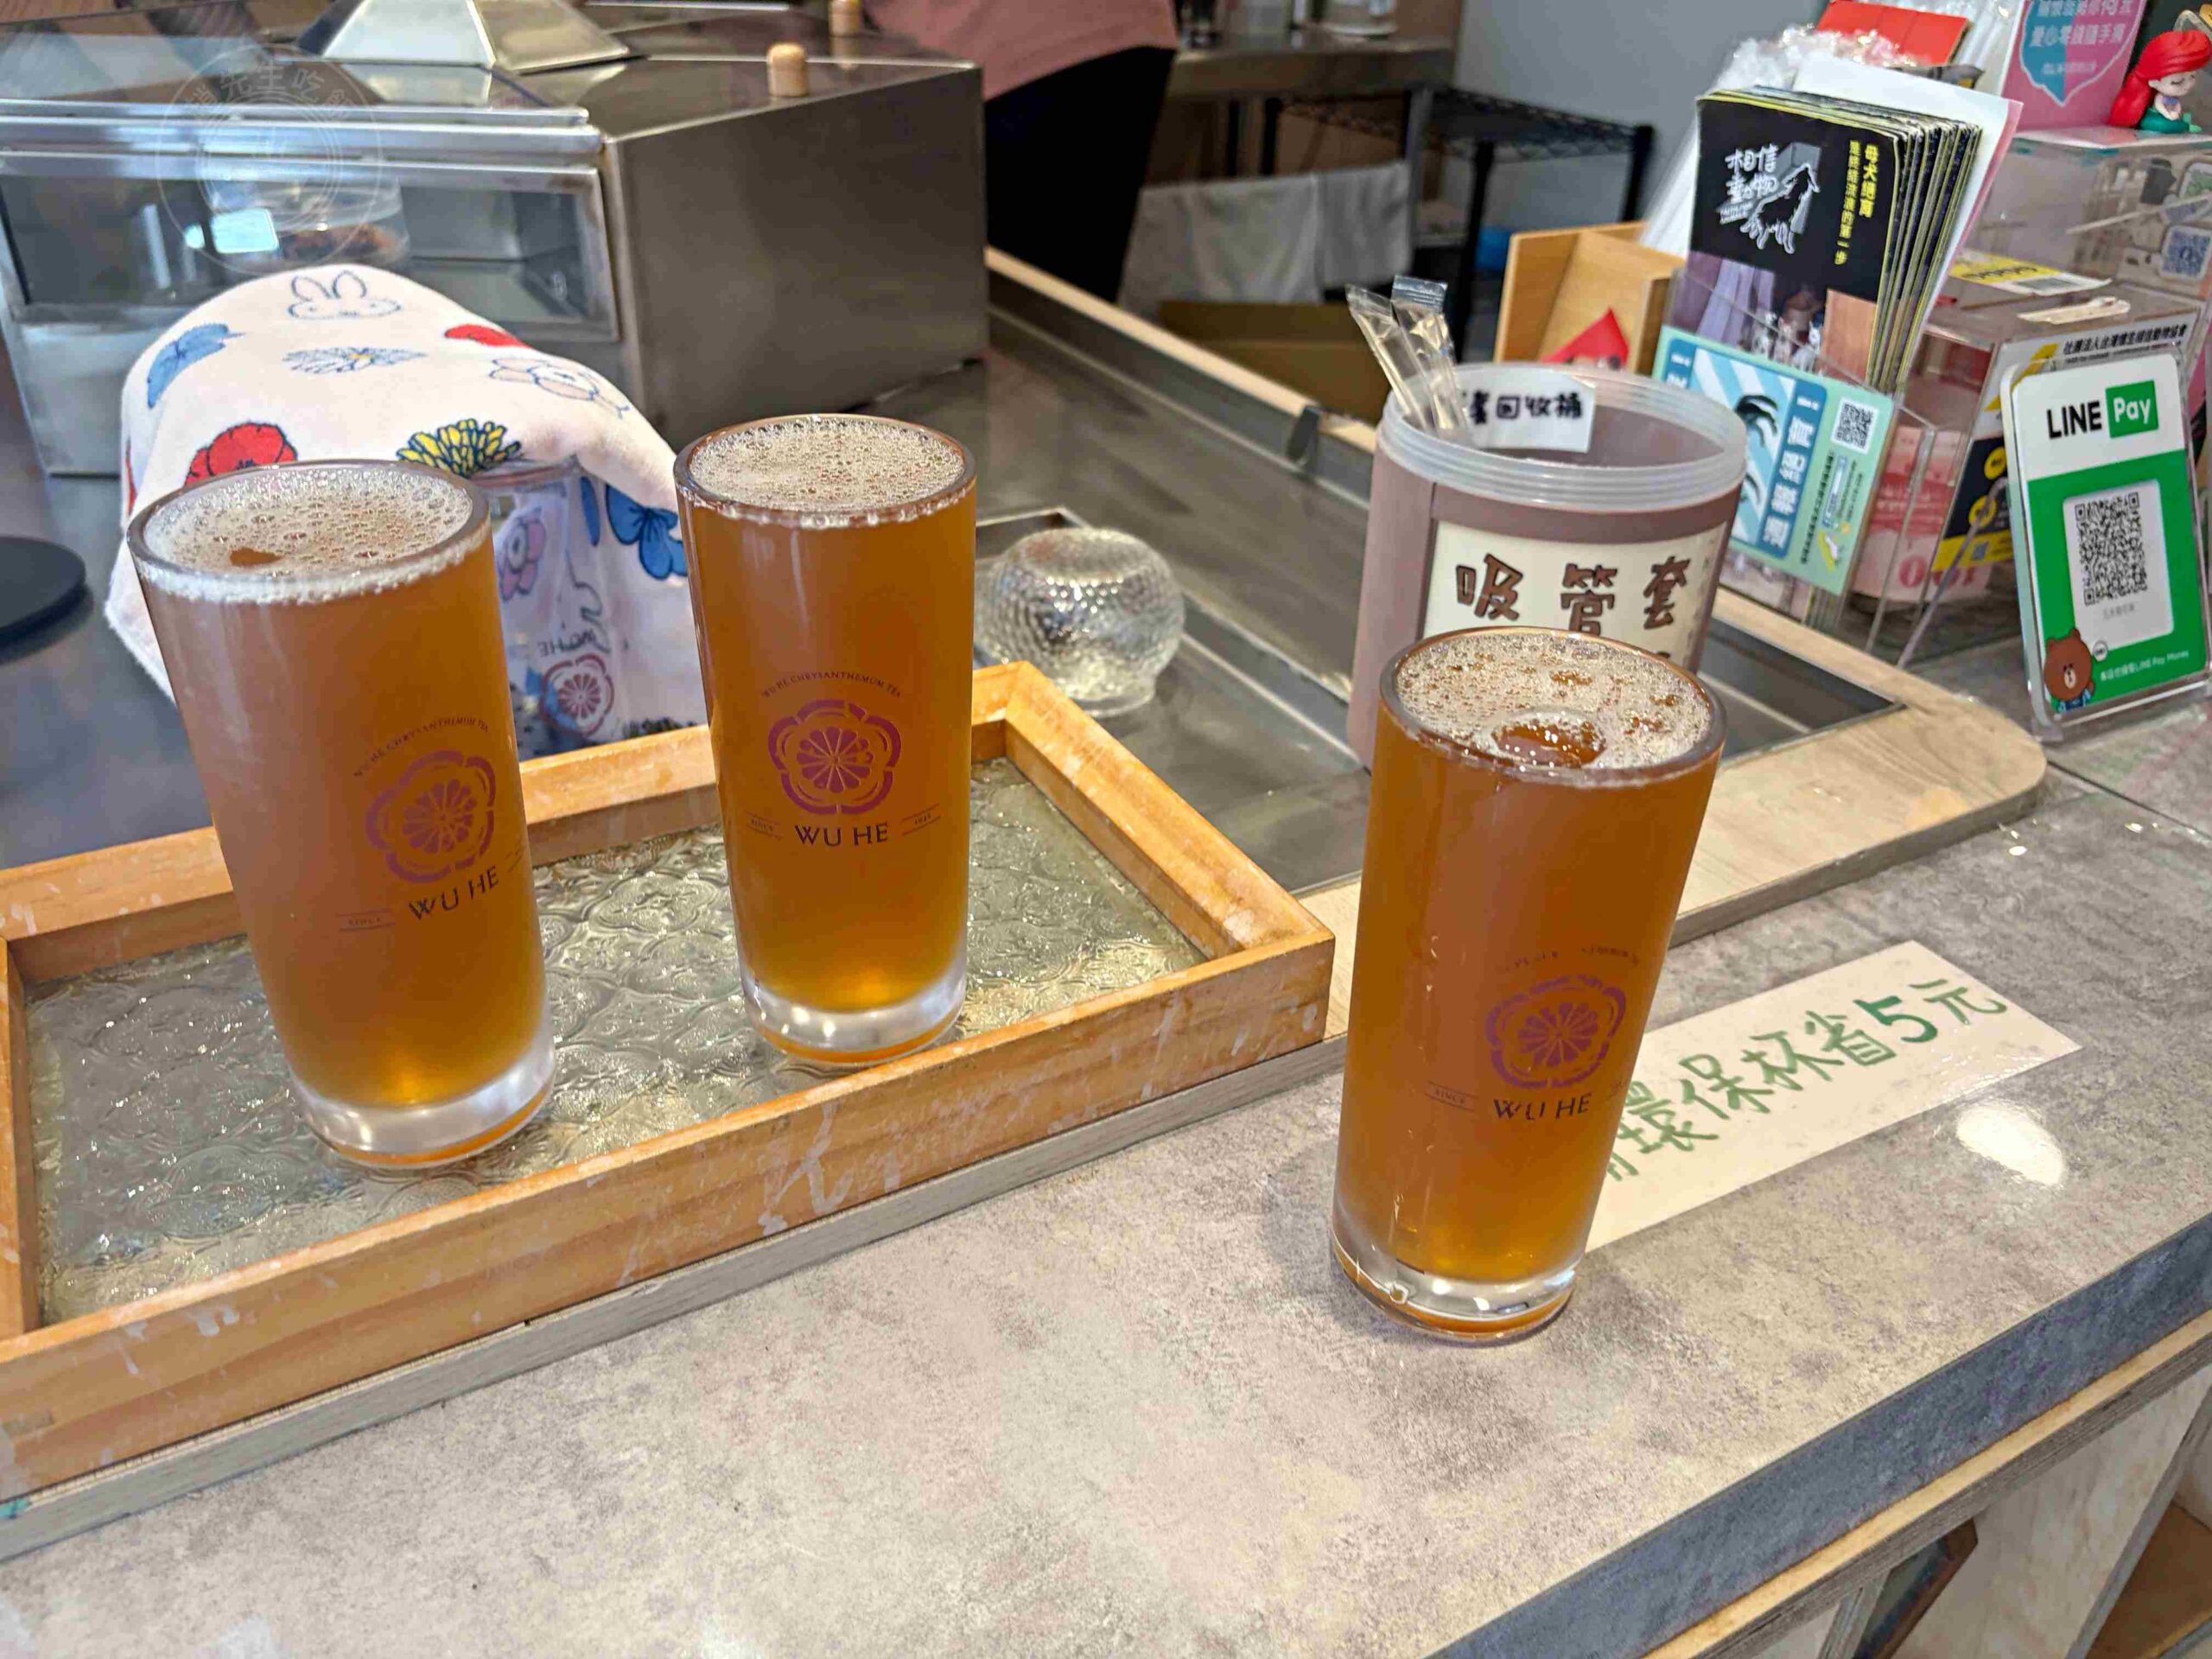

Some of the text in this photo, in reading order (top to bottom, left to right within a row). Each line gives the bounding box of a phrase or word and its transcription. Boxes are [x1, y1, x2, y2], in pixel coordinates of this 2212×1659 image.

[2047, 396, 2152, 440] LINE Pay
[1455, 553, 1691, 638] 吸管套
[790, 671, 885, 689] CHRYSANTHEMUM
[794, 823, 889, 848] WU HE
[409, 866, 499, 921] WU HE
[1493, 1093, 1592, 1121] WU HE
